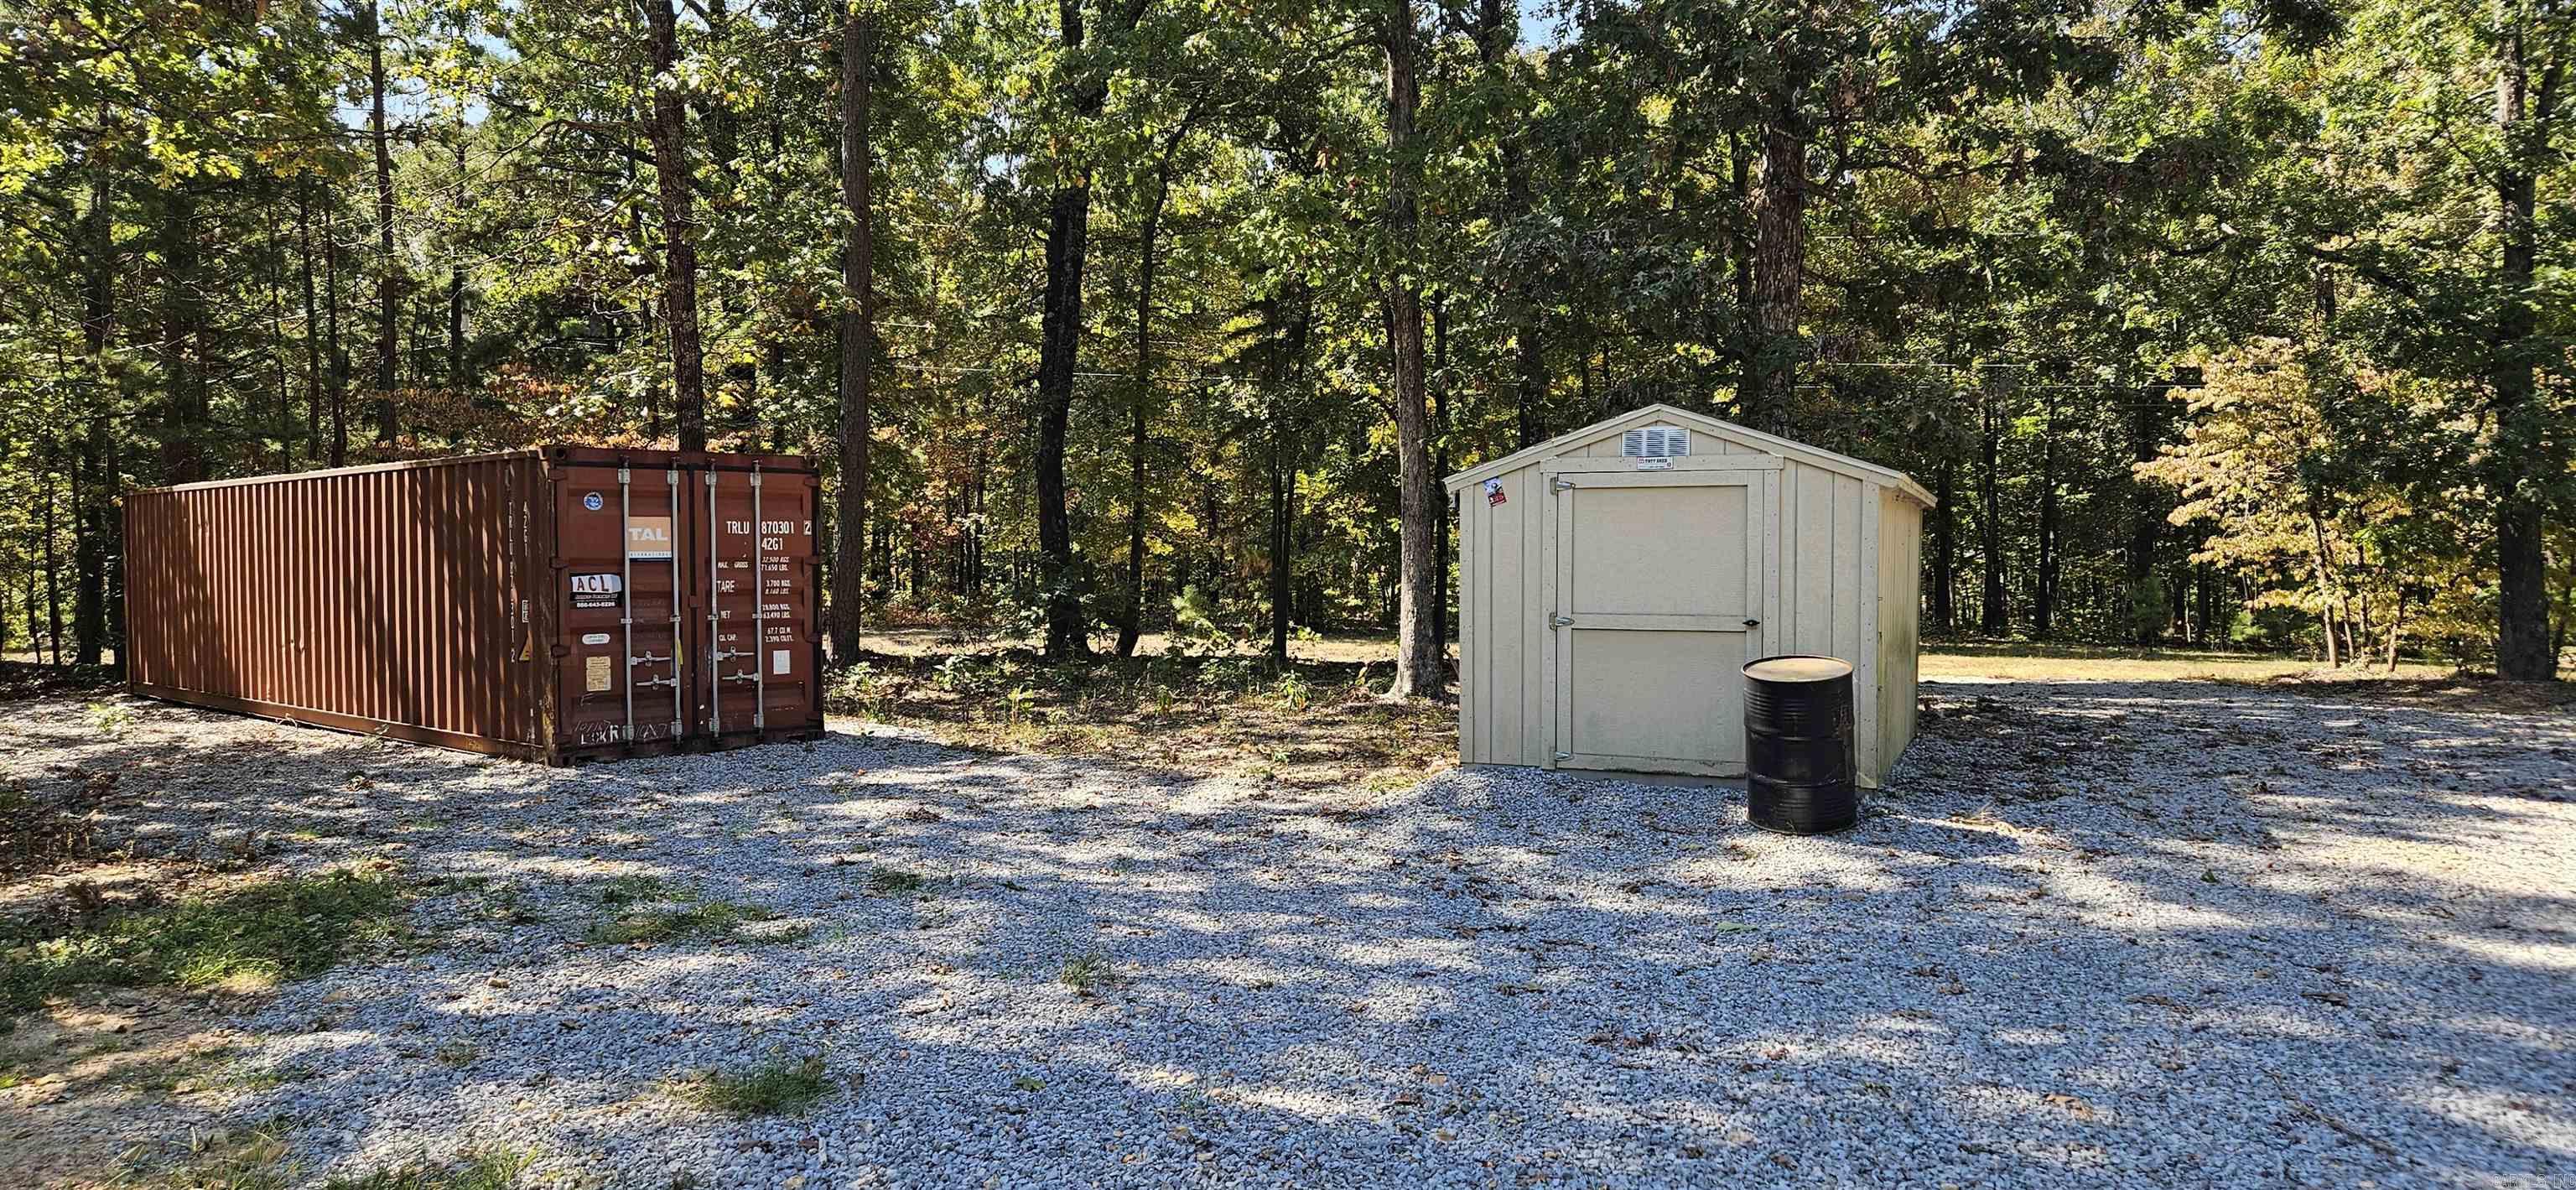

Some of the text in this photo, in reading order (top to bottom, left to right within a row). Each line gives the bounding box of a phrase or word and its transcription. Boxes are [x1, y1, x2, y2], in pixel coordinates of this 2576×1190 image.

[629, 527, 668, 541] TAL
[726, 521, 812, 535] TRLU 870301 2
[761, 538, 783, 550] 42G1
[717, 580, 735, 593] TARE
[720, 611, 731, 619] NET
